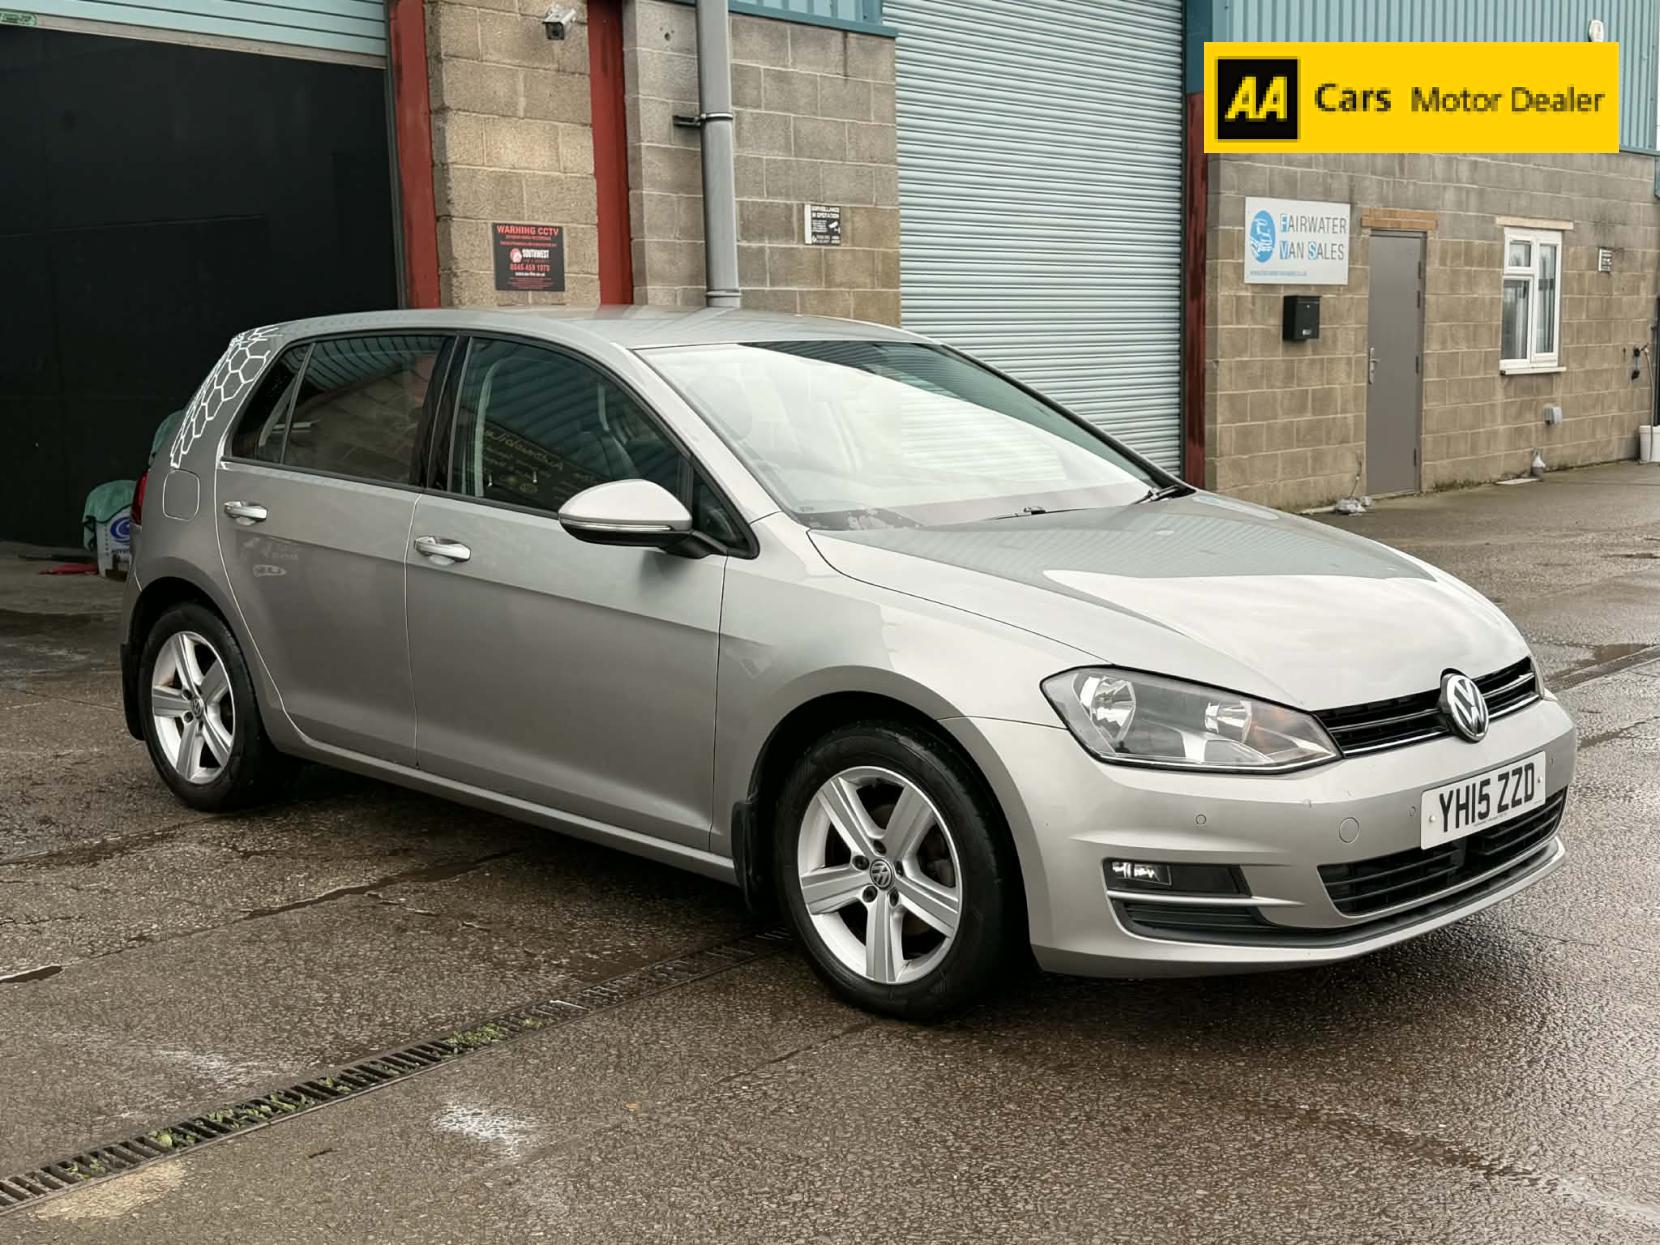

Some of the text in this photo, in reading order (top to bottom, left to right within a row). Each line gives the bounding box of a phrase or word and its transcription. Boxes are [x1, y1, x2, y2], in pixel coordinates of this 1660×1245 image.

[496, 225, 559, 236] WARNING CCTV
[1280, 213, 1347, 234] FAIRWATER
[1280, 240, 1344, 260] VAN SALES
[1439, 762, 1534, 832] YH15 ZZD
